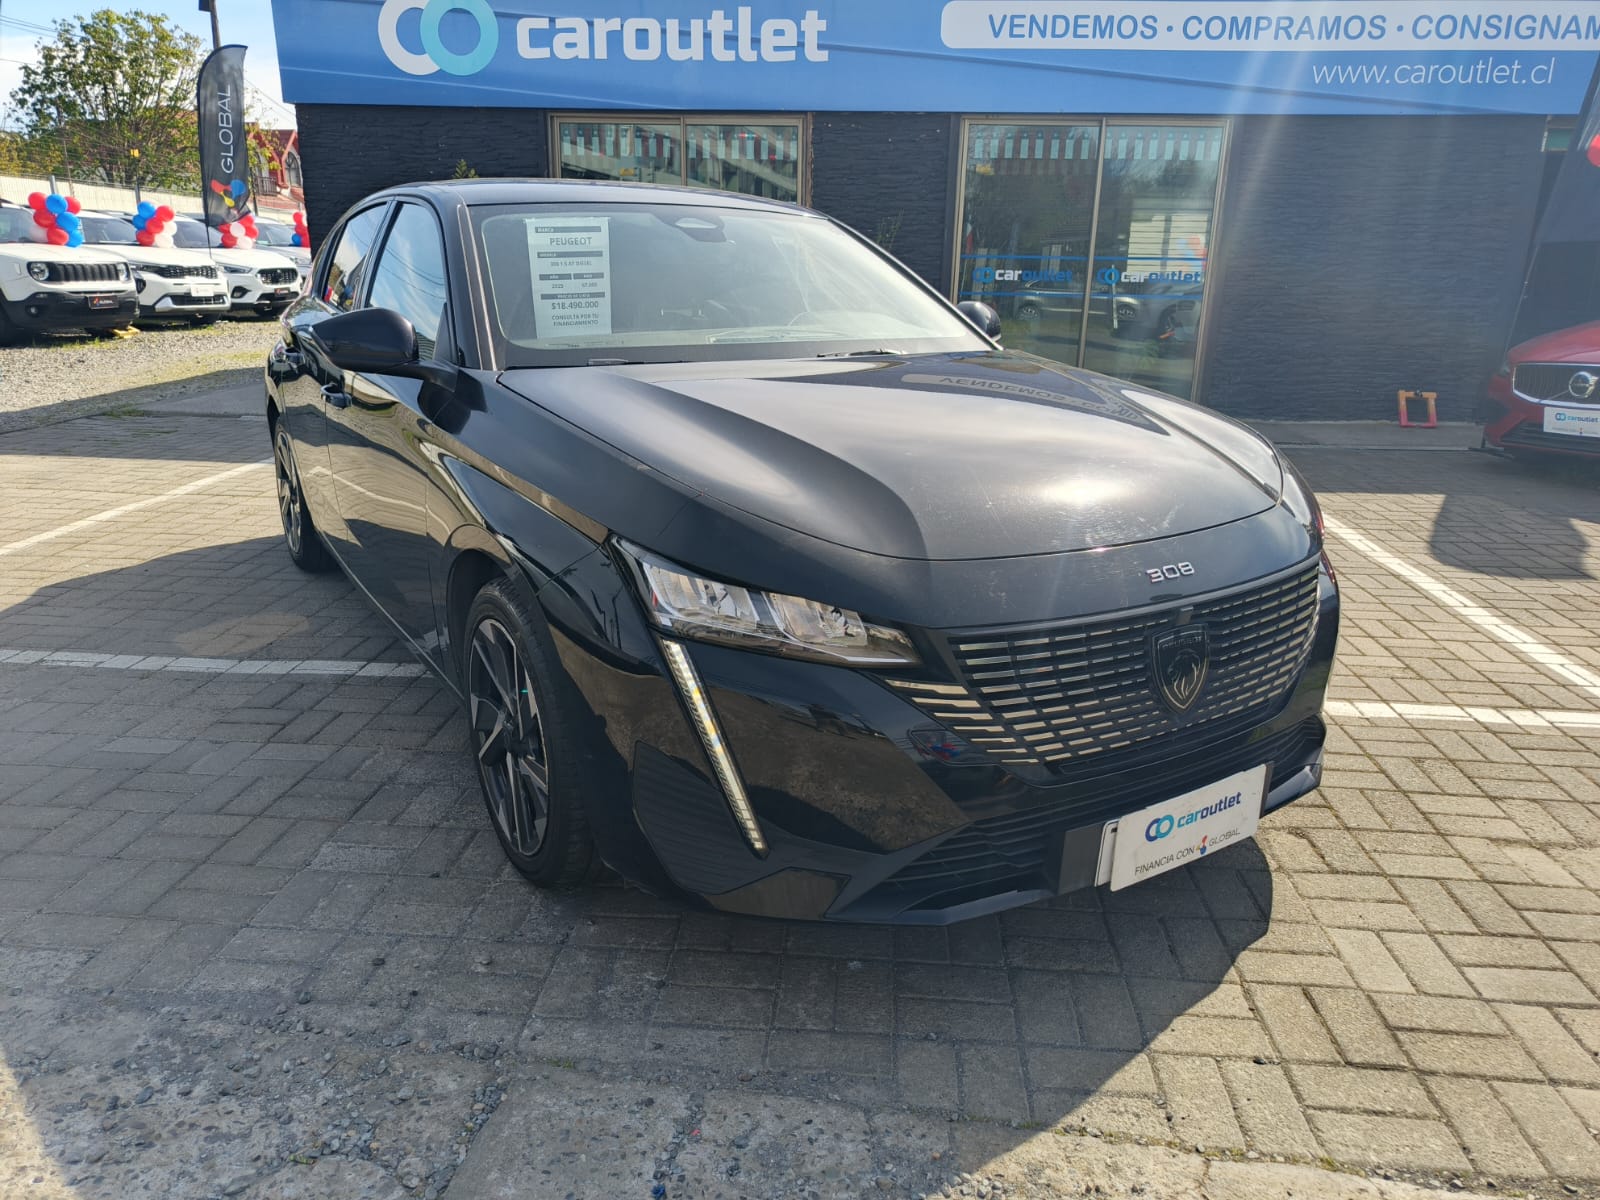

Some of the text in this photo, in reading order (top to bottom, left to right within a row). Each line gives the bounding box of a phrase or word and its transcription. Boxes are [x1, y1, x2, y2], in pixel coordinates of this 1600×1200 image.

[516, 6, 829, 62] caroutlet
[988, 14, 1158, 39] VENDEMOS
[1182, 15, 1387, 41] COMPRAMOS
[1311, 58, 1556, 86] www.caroutlet.cl
[217, 84, 235, 174] GLOBAL
[549, 236, 592, 246] PEUGEOT
[994, 267, 1073, 283] caroutlet
[1120, 268, 1202, 284] caroutlet
[1146, 561, 1195, 583] 308
[1177, 792, 1242, 828] caroutlet
[1134, 828, 1241, 876] FINANCIA CON GLOBAL
